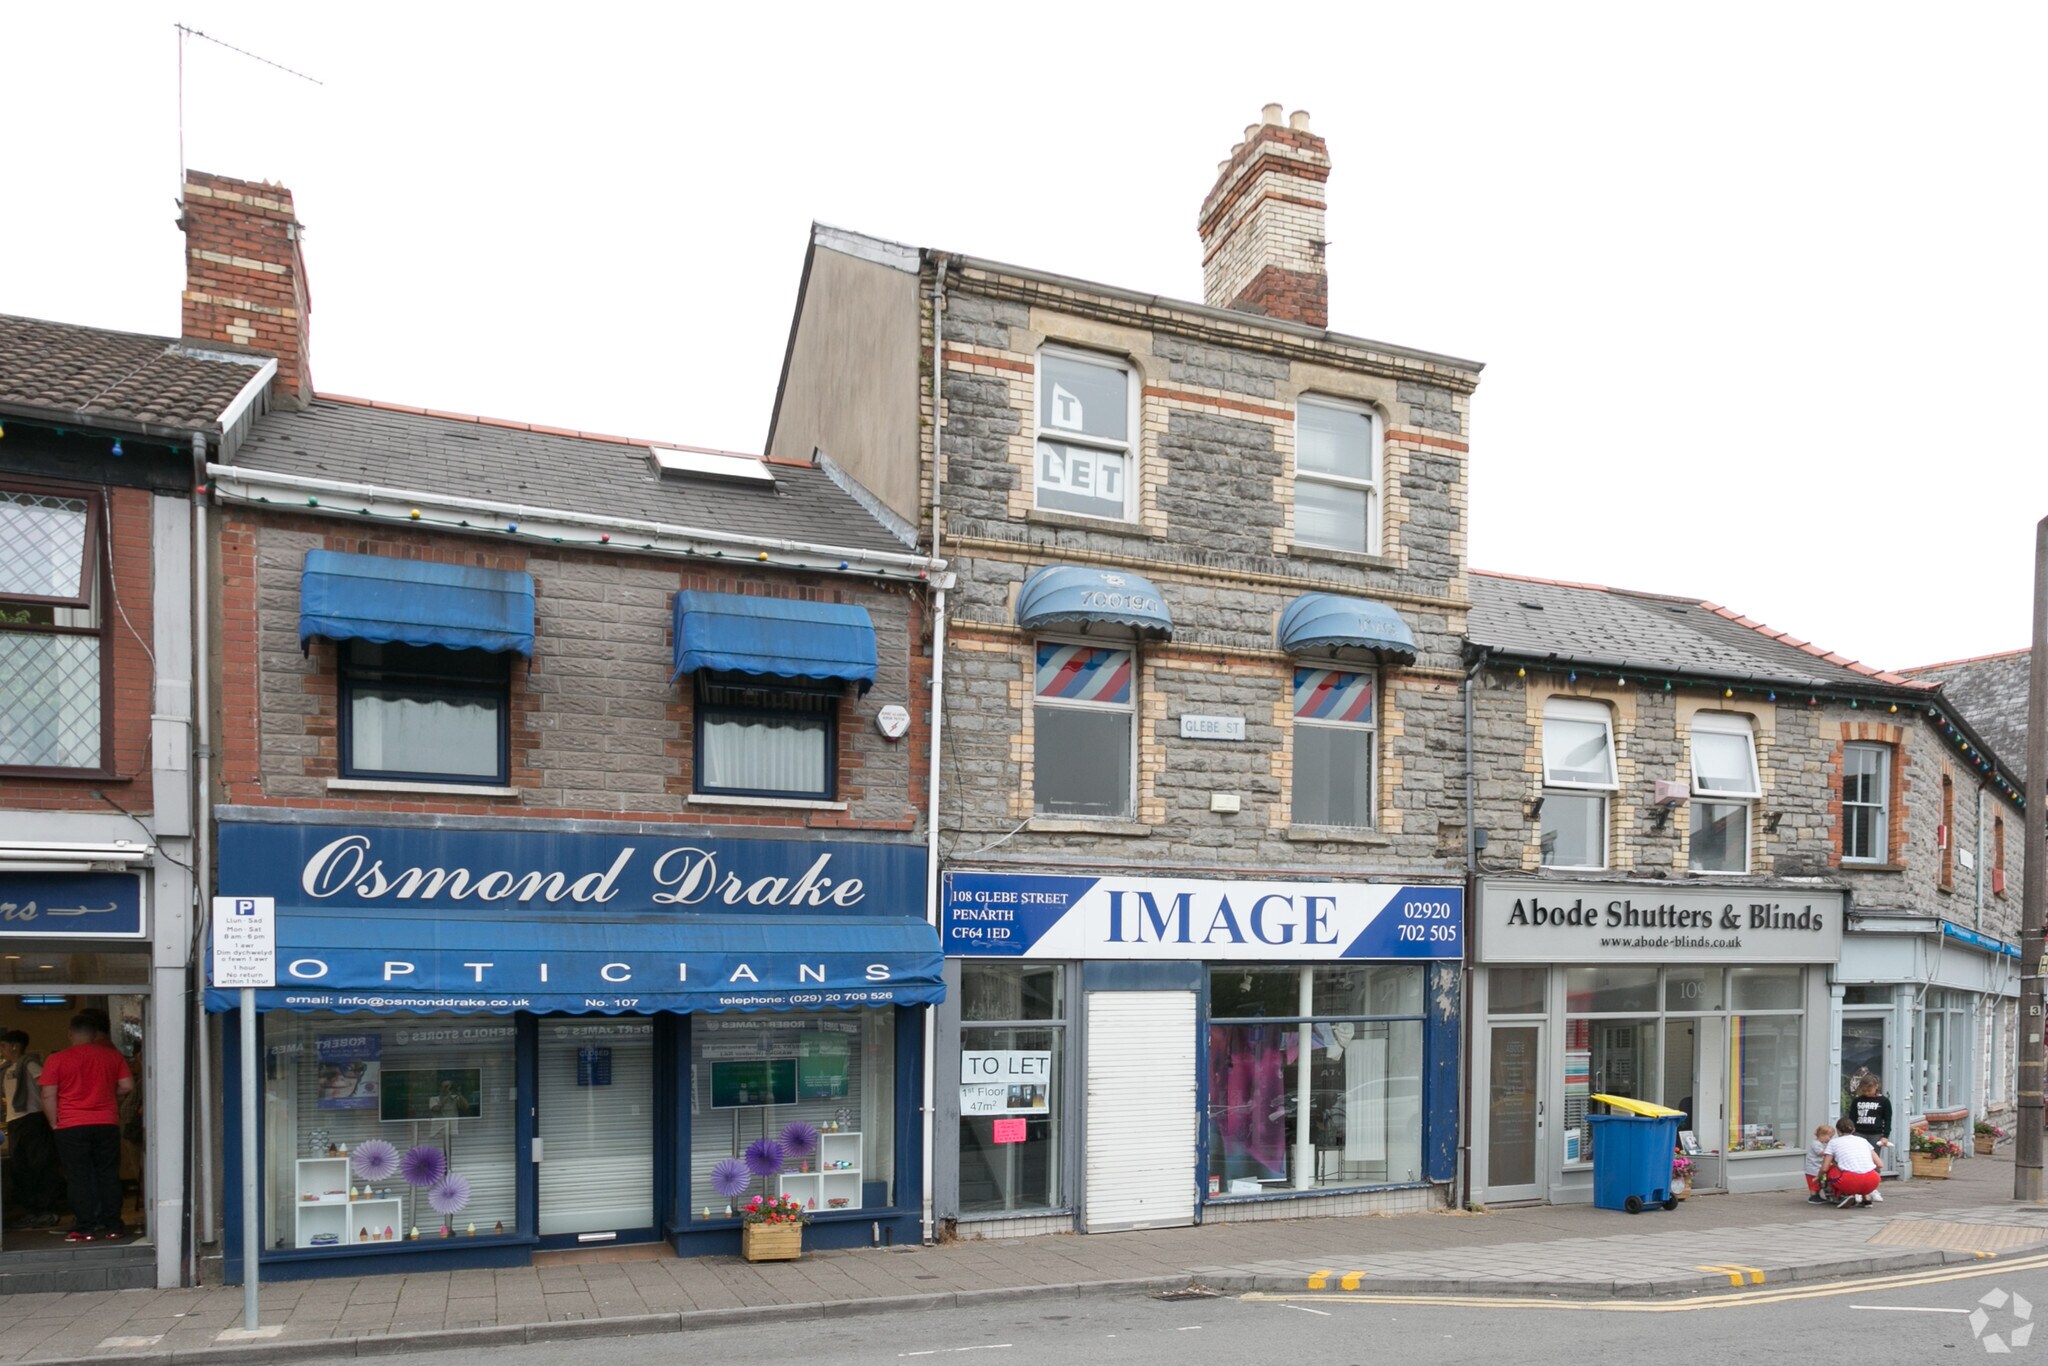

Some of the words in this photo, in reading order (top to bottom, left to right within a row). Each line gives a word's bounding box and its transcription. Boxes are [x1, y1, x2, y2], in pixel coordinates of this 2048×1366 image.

[1058, 394, 1076, 421] T
[1042, 454, 1120, 493] LET
[1185, 720, 1219, 733] GLEBE
[1226, 723, 1240, 734] ST
[302, 835, 635, 903] Osmond
[652, 846, 866, 907] Drake
[953, 891, 973, 902] 108
[975, 892, 1018, 904] GLEBE
[1020, 893, 1069, 905] STREET
[239, 901, 253, 915] P
[953, 909, 1014, 921] PENARTH
[1404, 902, 1451, 919] 02920
[1507, 898, 1598, 927] Abode
[1606, 900, 1713, 929] Shutters
[1719, 903, 1742, 930] &
[1749, 903, 1824, 932] Blinds
[1104, 889, 1339, 946] IMAGE
[952, 927, 983, 939] CF64
[987, 928, 1011, 939] 1ED
[1397, 924, 1425, 941] 702
[1429, 925, 1457, 942] 505
[1601, 935, 1742, 949] www.abode-blinds.co.uk
[288, 958, 892, 984] OPTICIANS
[285, 995, 333, 1005] email:
[338, 996, 530, 1008] info@osmonddrake.co.uk
[584, 998, 609, 1007] No.
[613, 998, 639, 1007] 107
[719, 996, 786, 1006] telephone:
[789, 994, 822, 1004] (029)
[825, 993, 841, 1002] 20
[844, 992, 868, 1001] 709
[870, 991, 893, 1000] 526
[2032, 1007, 2039, 1015] 3
[968, 1057, 999, 1075] TO
[1009, 1057, 1049, 1075] LET
[962, 1087, 974, 1097] 1st
[977, 1087, 1005, 1097] Floor
